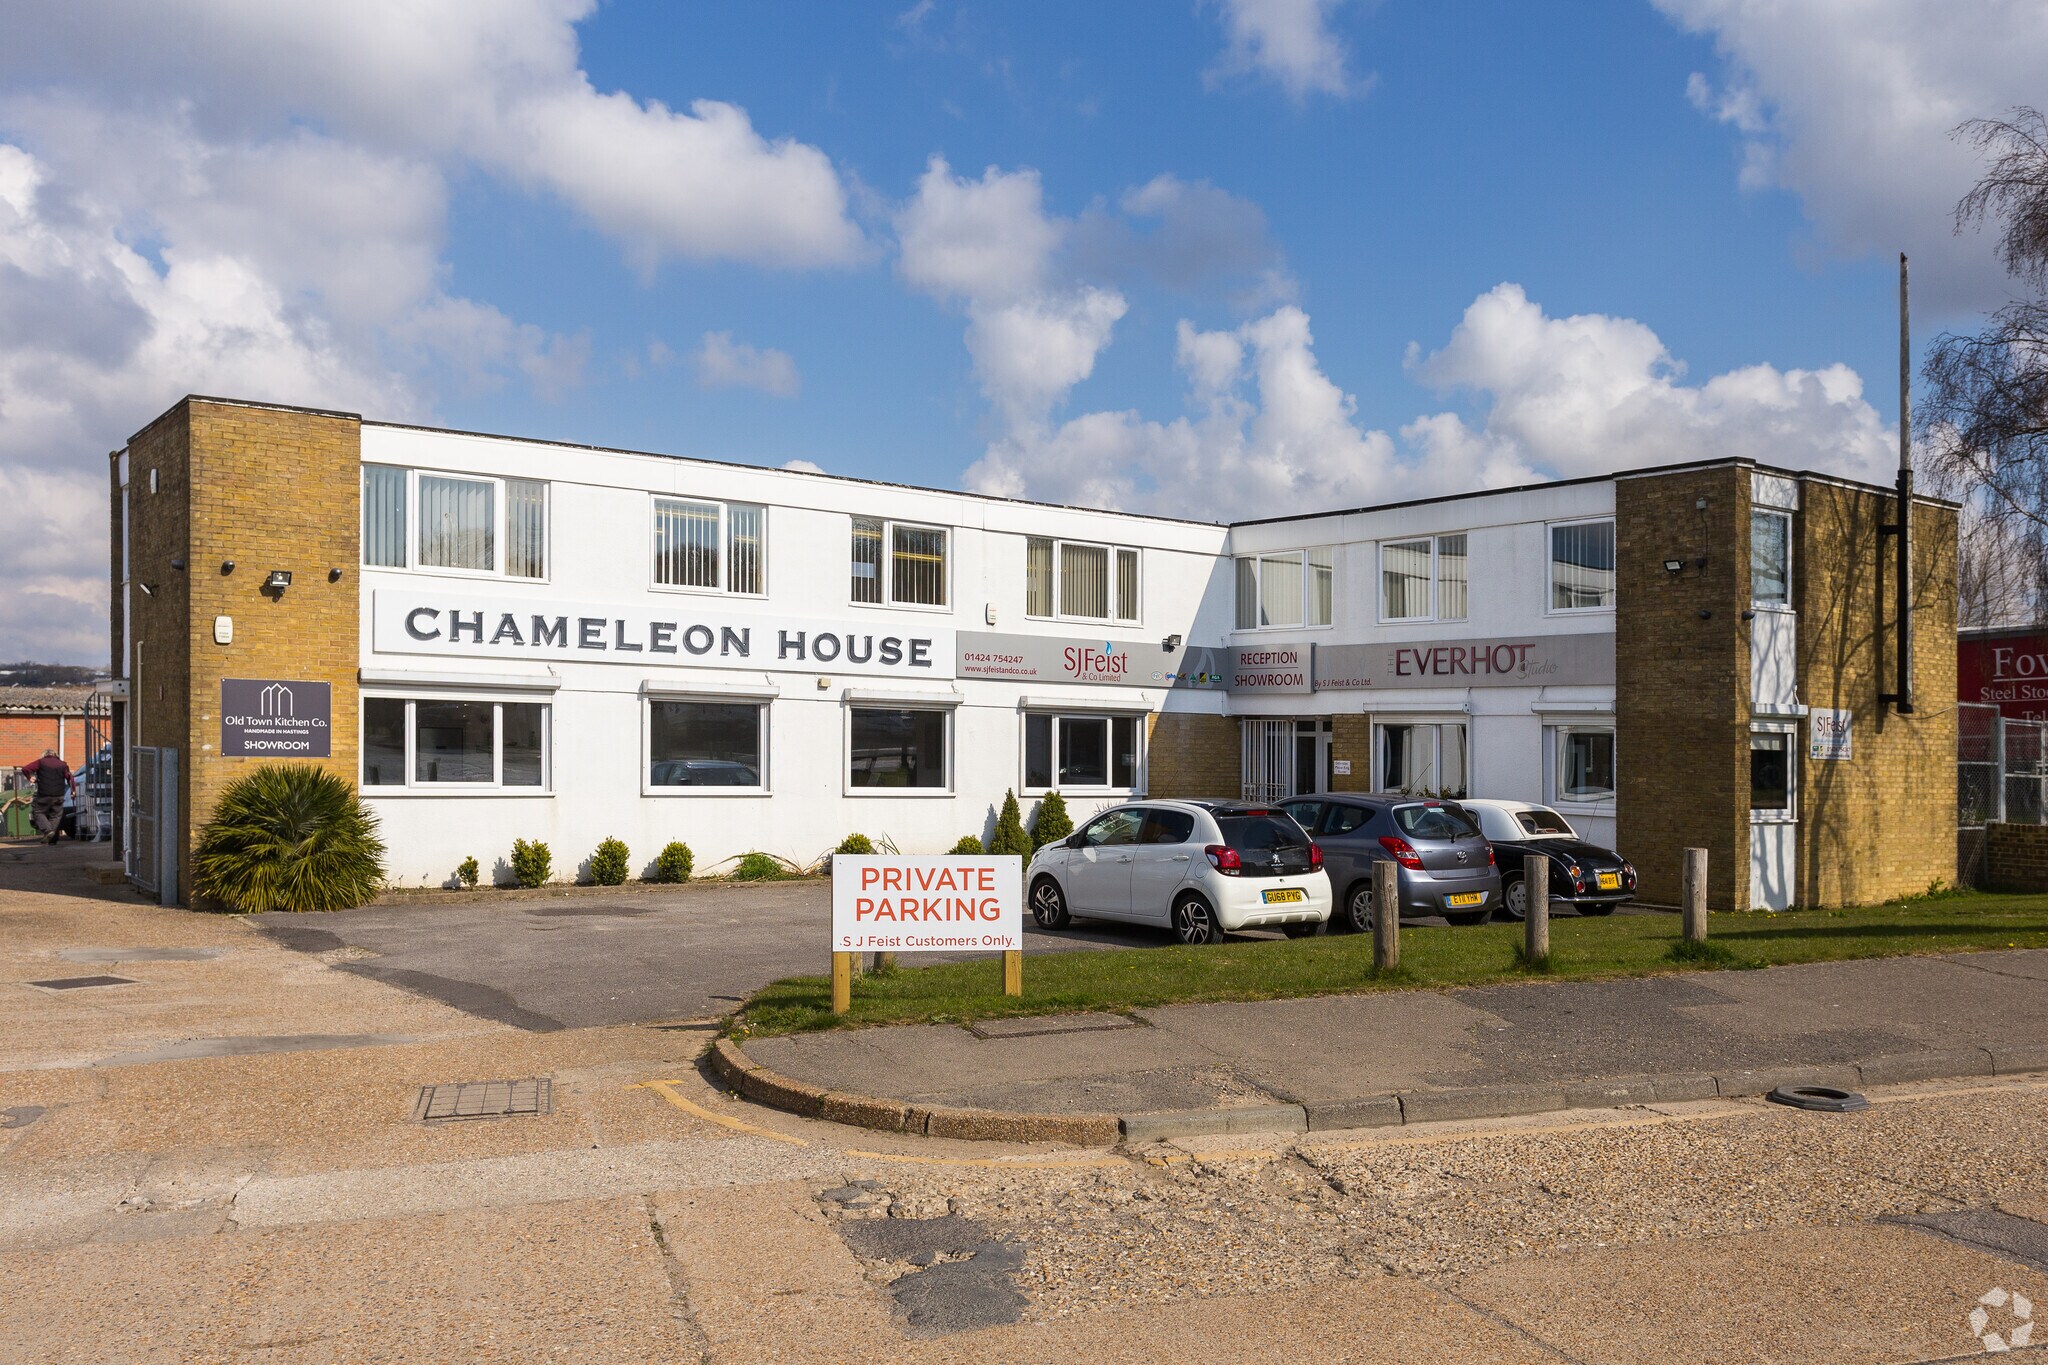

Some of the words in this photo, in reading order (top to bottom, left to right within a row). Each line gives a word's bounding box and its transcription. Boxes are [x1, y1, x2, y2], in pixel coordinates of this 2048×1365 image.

[404, 606, 751, 658] CHAMELEON
[777, 630, 933, 668] HOUSE
[965, 653, 991, 662] 01424
[993, 654, 1024, 664] 754247
[1241, 652, 1298, 665] RECEPTION
[1396, 644, 1535, 676] EVERHOT
[965, 666, 1037, 677] www.sjfeistandco.co.uk
[1516, 659, 1559, 680] Studio
[1089, 673, 1098, 681] Co
[1099, 674, 1121, 682] Limited
[1235, 673, 1304, 687] SHOWROOM
[1315, 680, 1322, 689] By
[1332, 679, 1344, 687] Feist
[1981, 687, 2016, 700] Steel
[225, 716, 244, 726] Old
[247, 717, 272, 726] Town
[275, 717, 310, 727] Kitchen
[312, 718, 327, 727] Co.
[244, 741, 310, 751] SHOWROOM
[862, 868, 995, 891] PRIVATE
[1267, 892, 1286, 902] GU68
[1286, 891, 1301, 901] PYG
[856, 898, 1000, 922] PARKING
[843, 936, 851, 947] S
[856, 936, 863, 947] J
[868, 936, 901, 947] Feist
[905, 935, 977, 947] Customers
